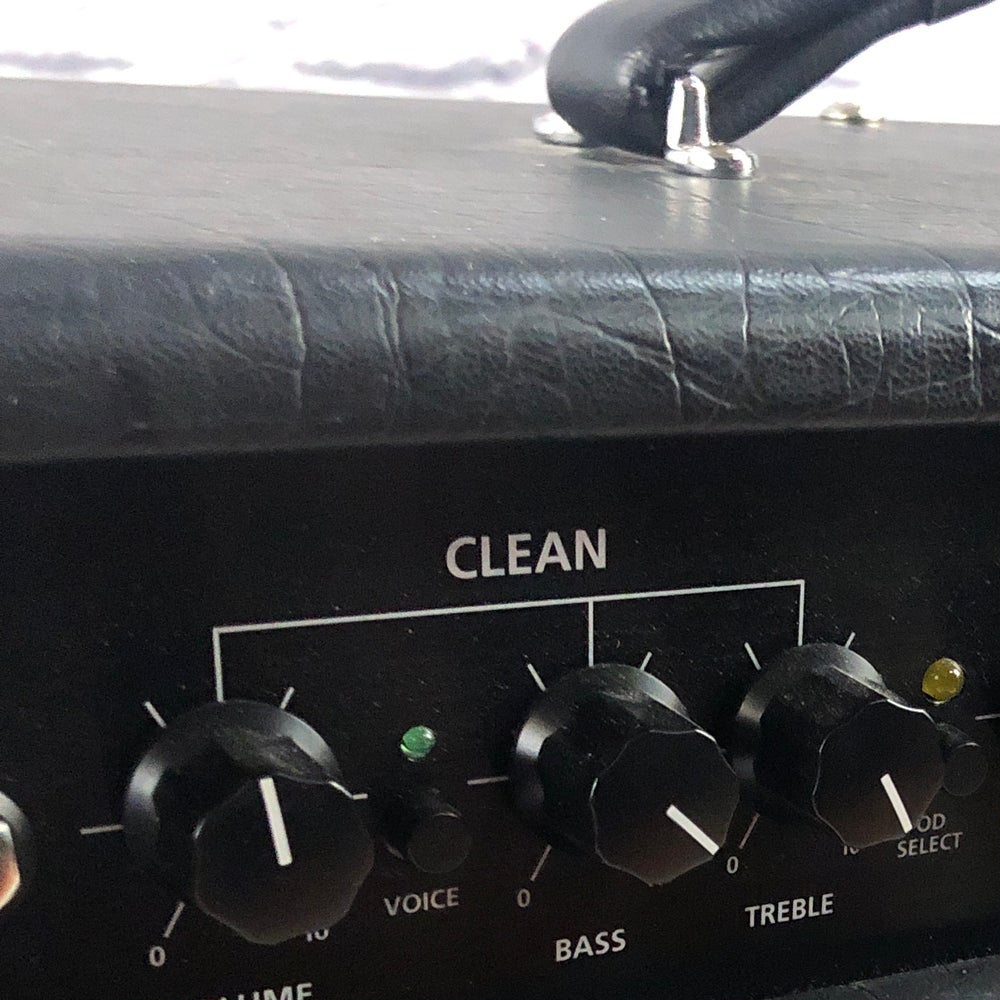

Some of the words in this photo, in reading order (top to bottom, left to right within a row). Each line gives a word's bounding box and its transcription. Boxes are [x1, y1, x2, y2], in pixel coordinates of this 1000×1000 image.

[445, 528, 607, 580] CLEAN
[915, 813, 946, 833] OD
[896, 832, 964, 858] SELECT
[726, 855, 739, 874] 0
[383, 887, 459, 916] VOICE
[516, 888, 531, 908] 0
[744, 892, 834, 928] TREBLE
[148, 945, 166, 967] 0
[555, 928, 626, 962] BASS
